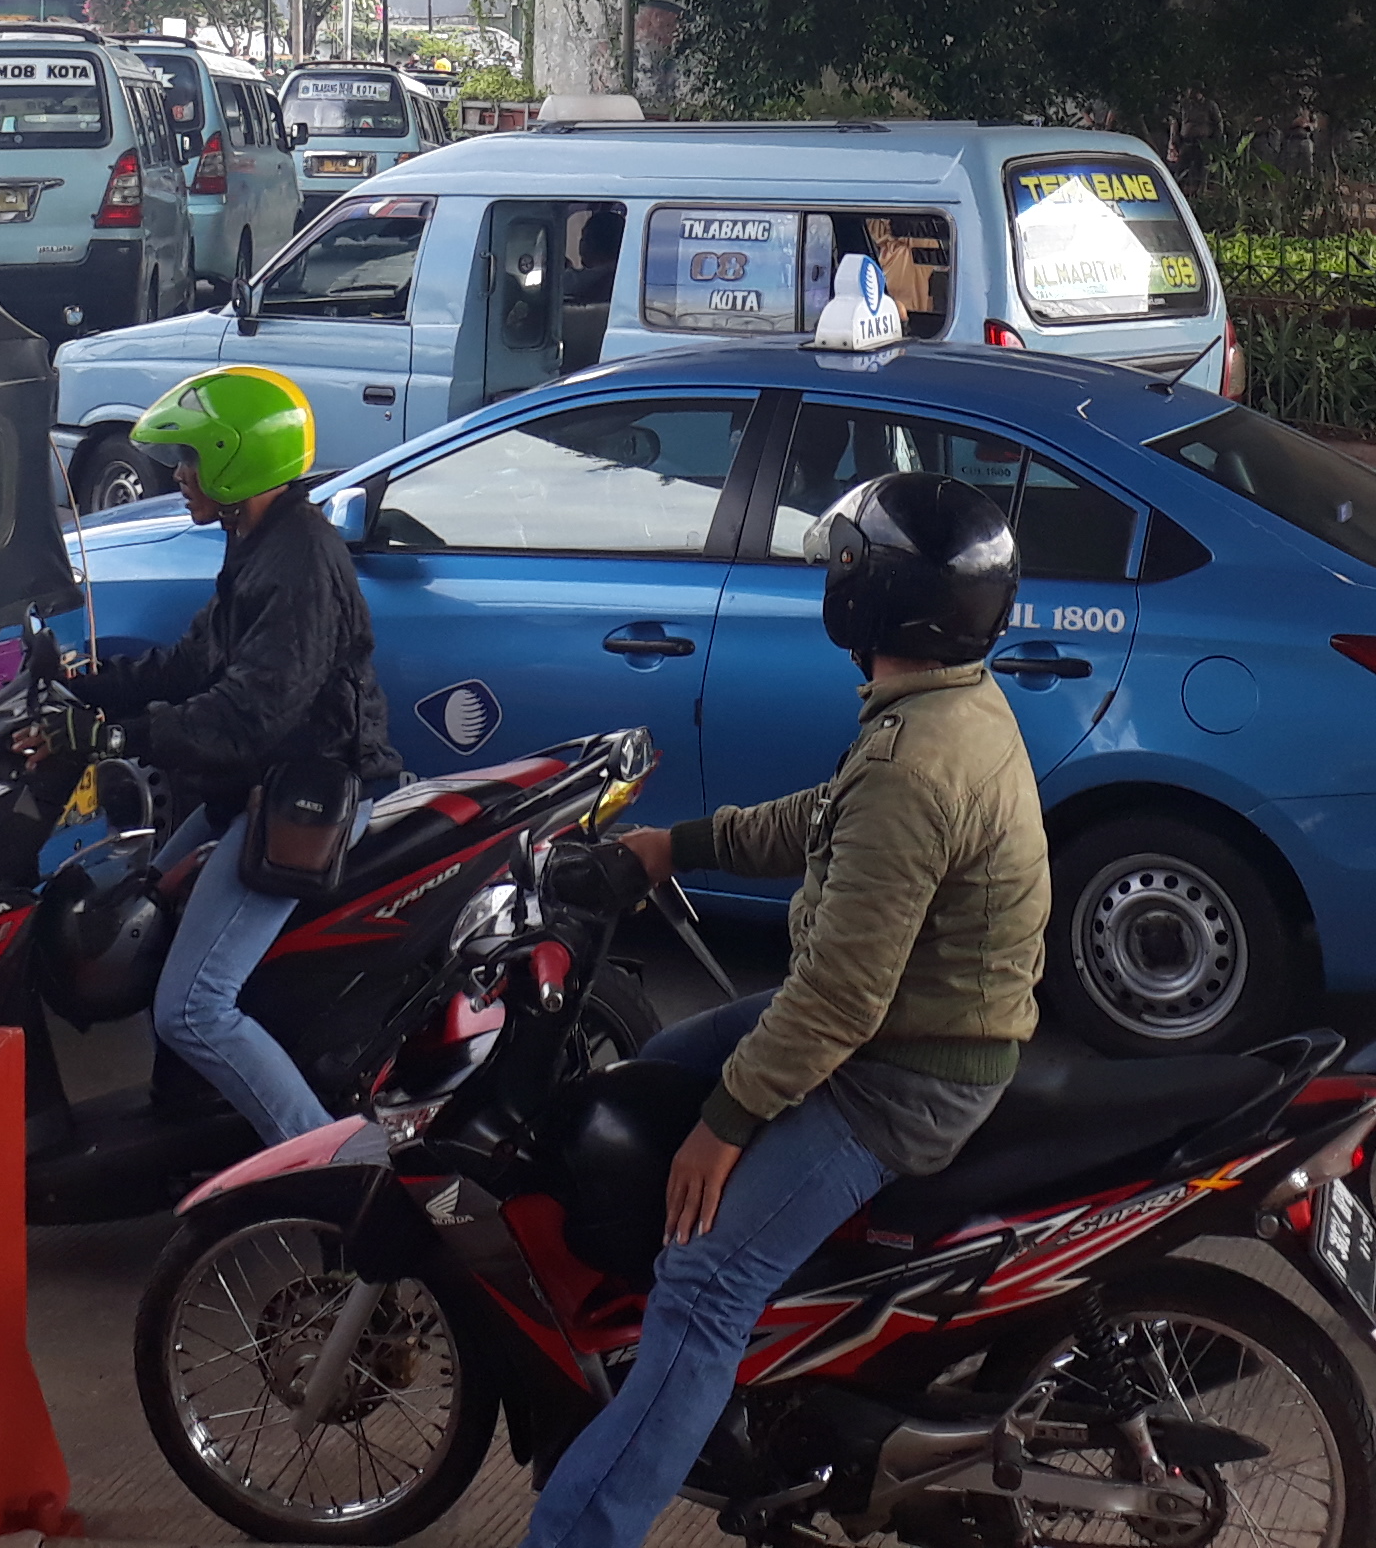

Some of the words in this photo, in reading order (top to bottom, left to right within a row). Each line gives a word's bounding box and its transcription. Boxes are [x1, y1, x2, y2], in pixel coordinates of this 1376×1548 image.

[47, 65, 91, 80] KOTA
[682, 219, 771, 240] TN.ABANG
[710, 290, 760, 311] KOTA
[859, 314, 895, 339] TAKSI
[1051, 605, 1126, 634] 1800
